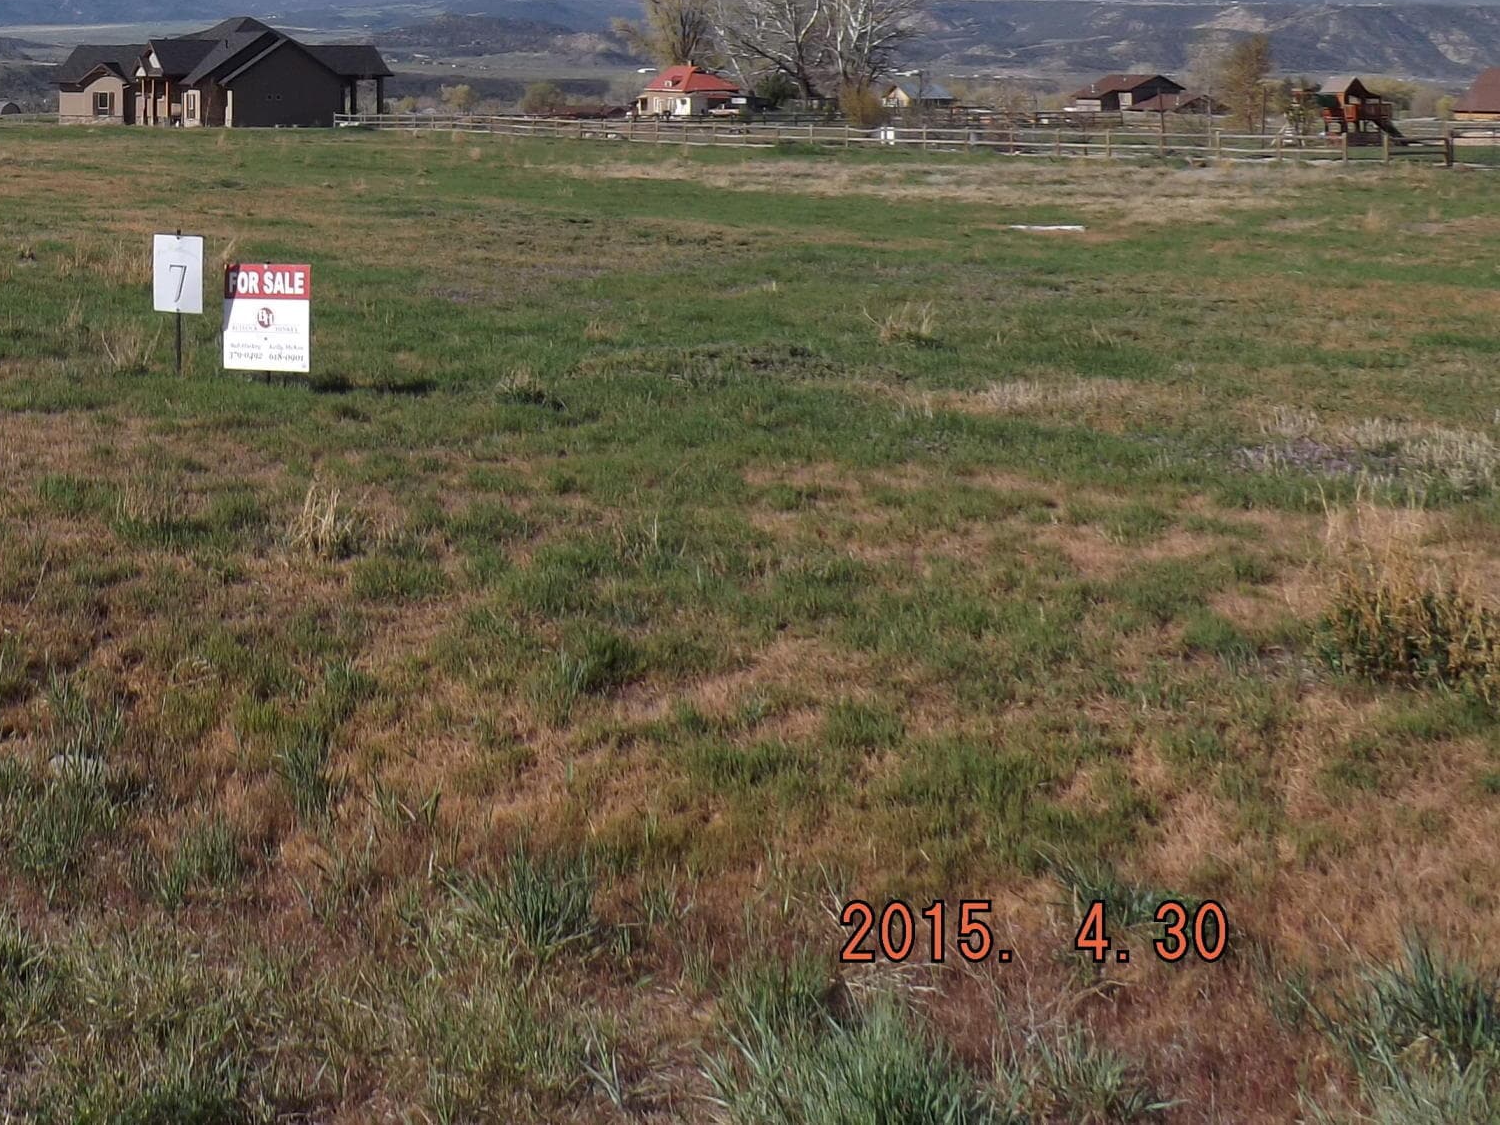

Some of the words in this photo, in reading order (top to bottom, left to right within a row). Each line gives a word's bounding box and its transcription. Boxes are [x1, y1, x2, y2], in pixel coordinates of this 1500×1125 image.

[169, 264, 187, 303] 7
[228, 271, 259, 294] FOR
[263, 271, 304, 294] SALE
